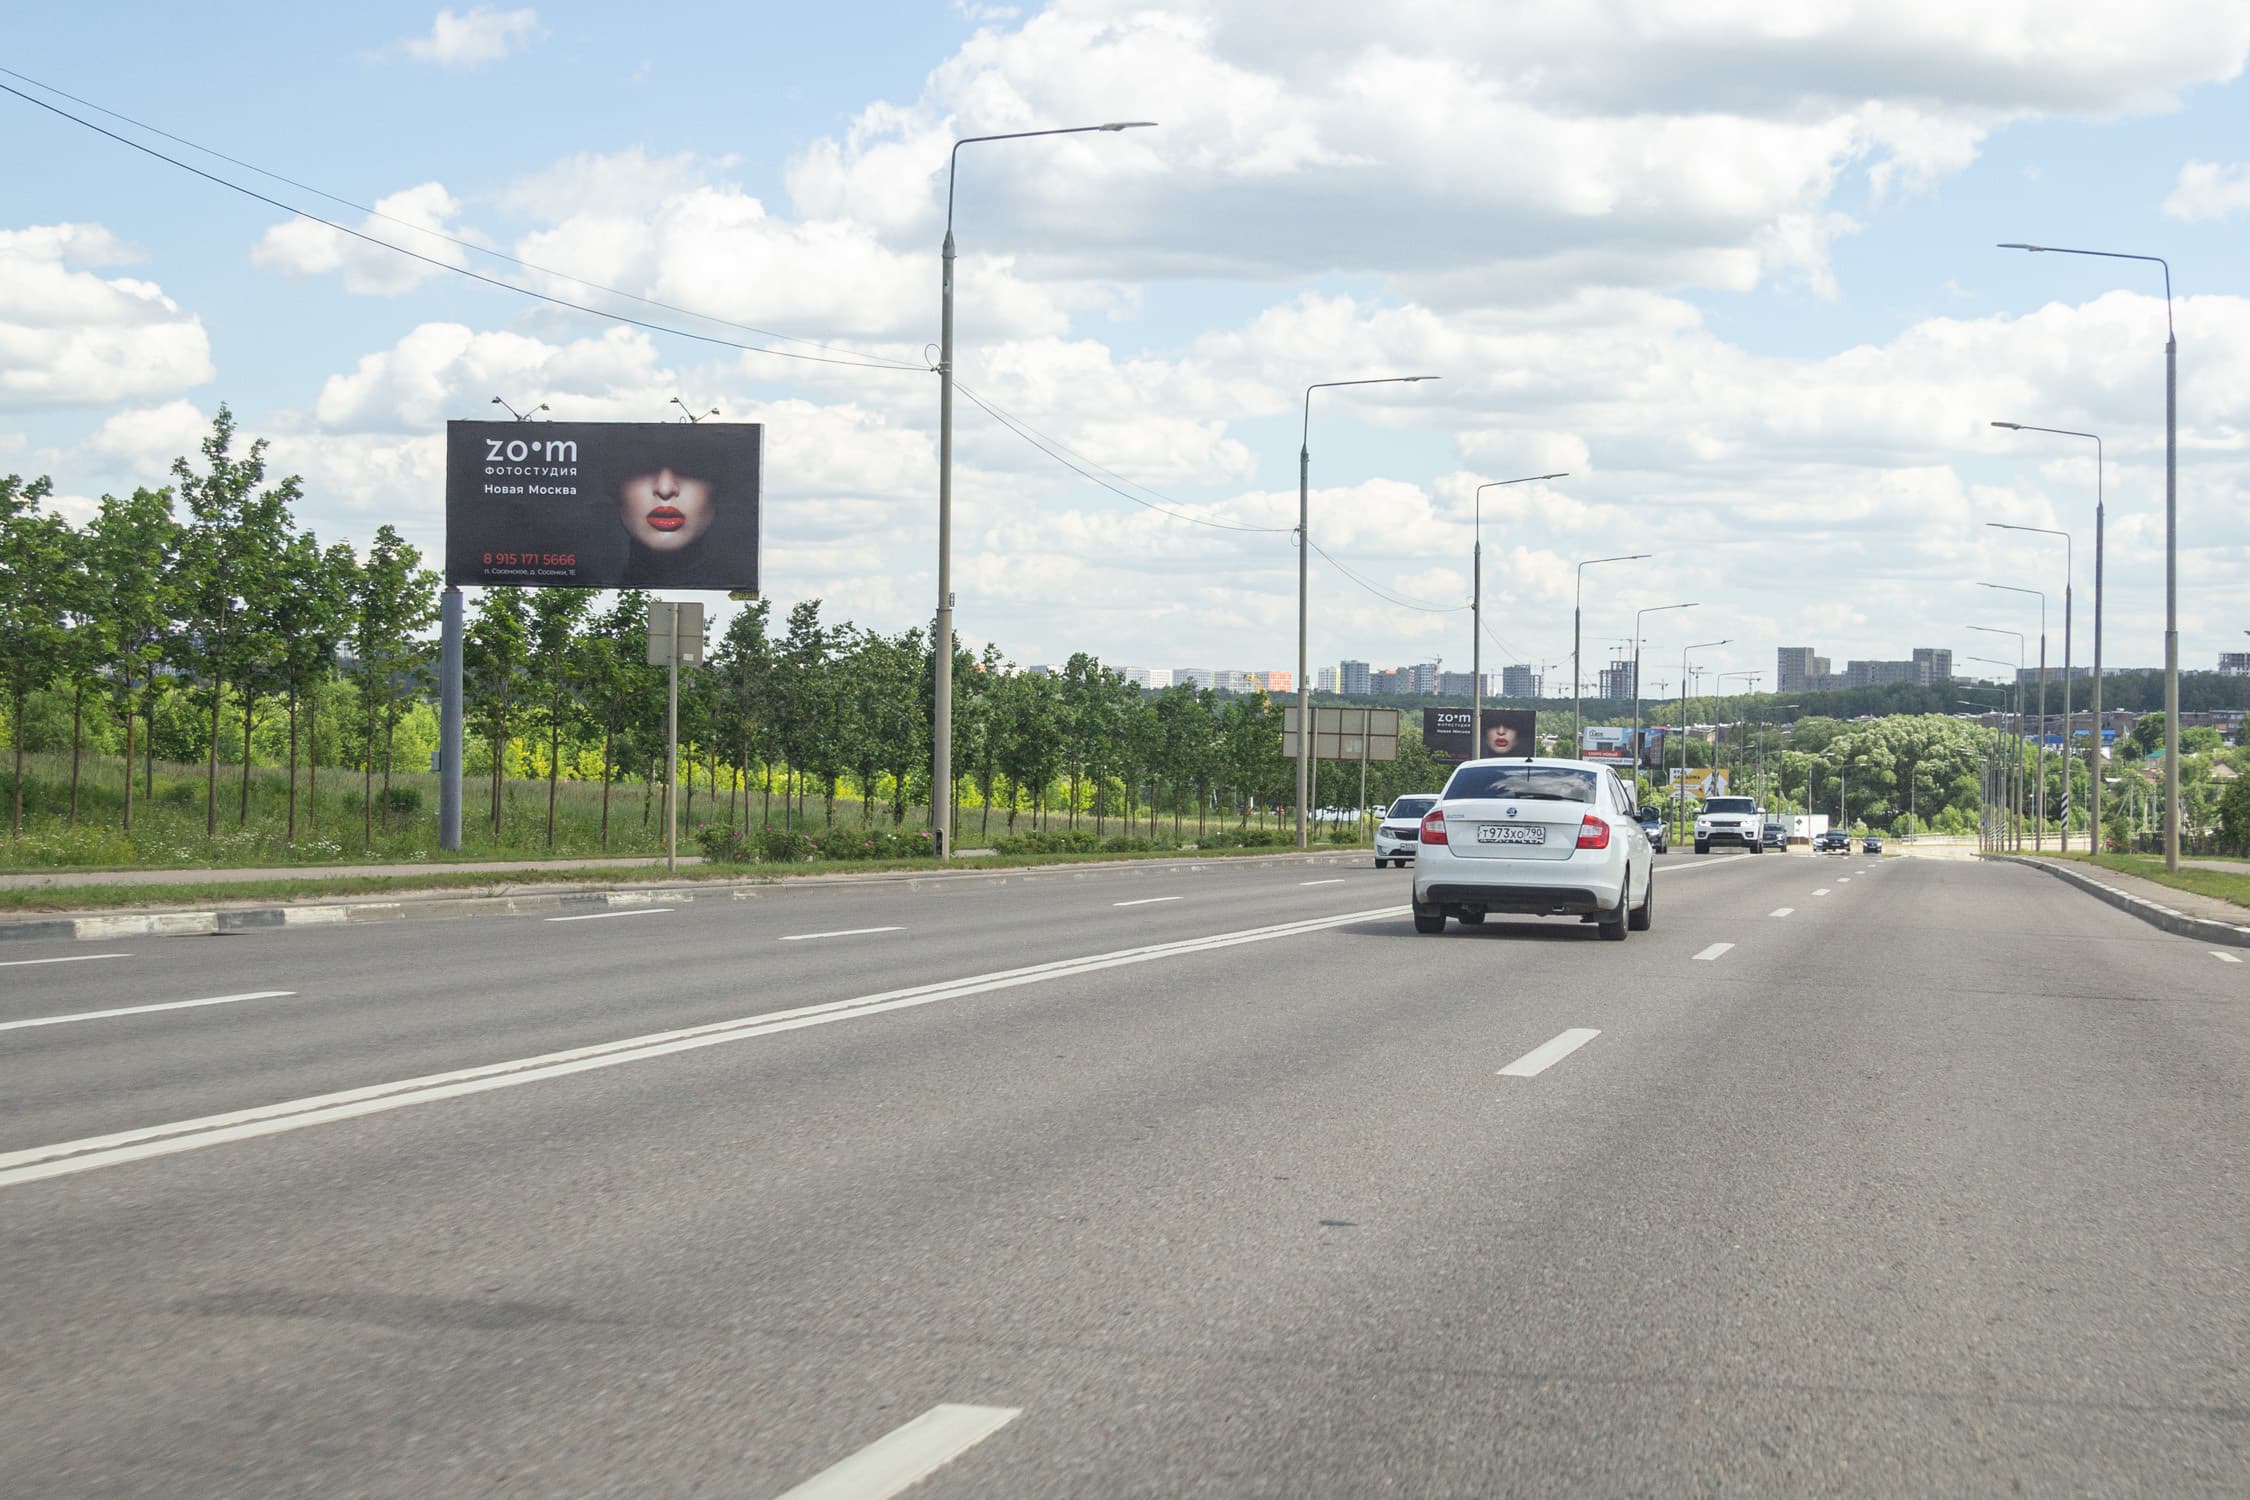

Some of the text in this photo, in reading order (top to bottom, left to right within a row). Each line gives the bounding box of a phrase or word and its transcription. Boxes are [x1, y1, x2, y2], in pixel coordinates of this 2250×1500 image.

[485, 466, 577, 477] ФОТОСТУДИЯ
[484, 484, 577, 495] Новая Москва
[483, 552, 576, 566] 8 915 171 5666
